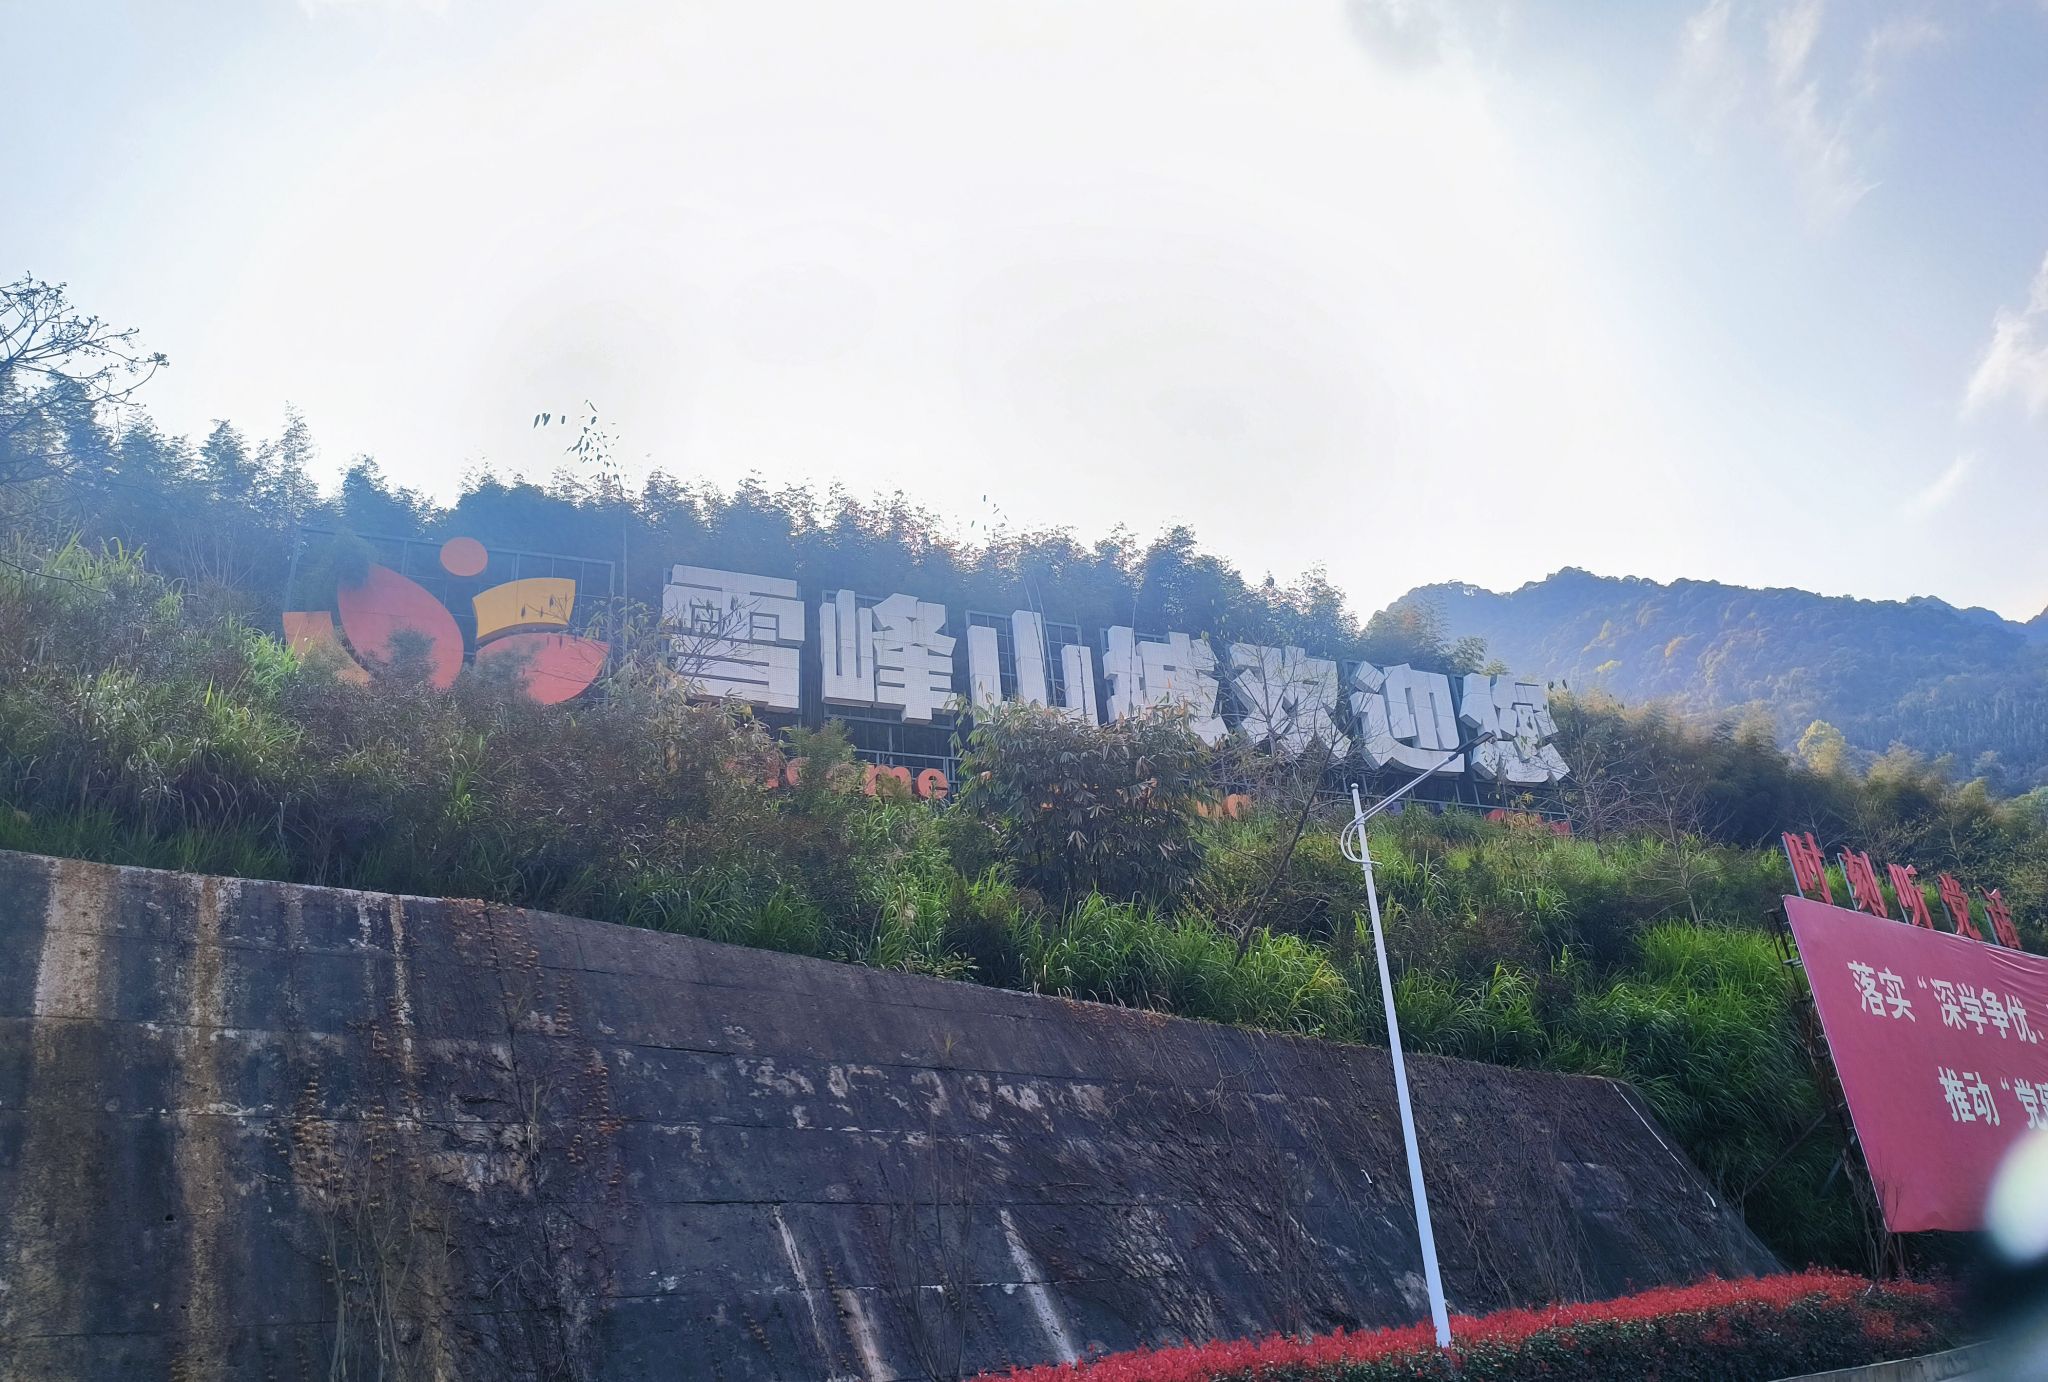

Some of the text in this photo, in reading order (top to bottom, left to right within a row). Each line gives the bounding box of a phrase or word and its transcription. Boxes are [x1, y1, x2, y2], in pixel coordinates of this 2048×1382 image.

[1781, 831, 2022, 950] 时刻听党话
[1847, 960, 2048, 1044] 落实“深学争优、
